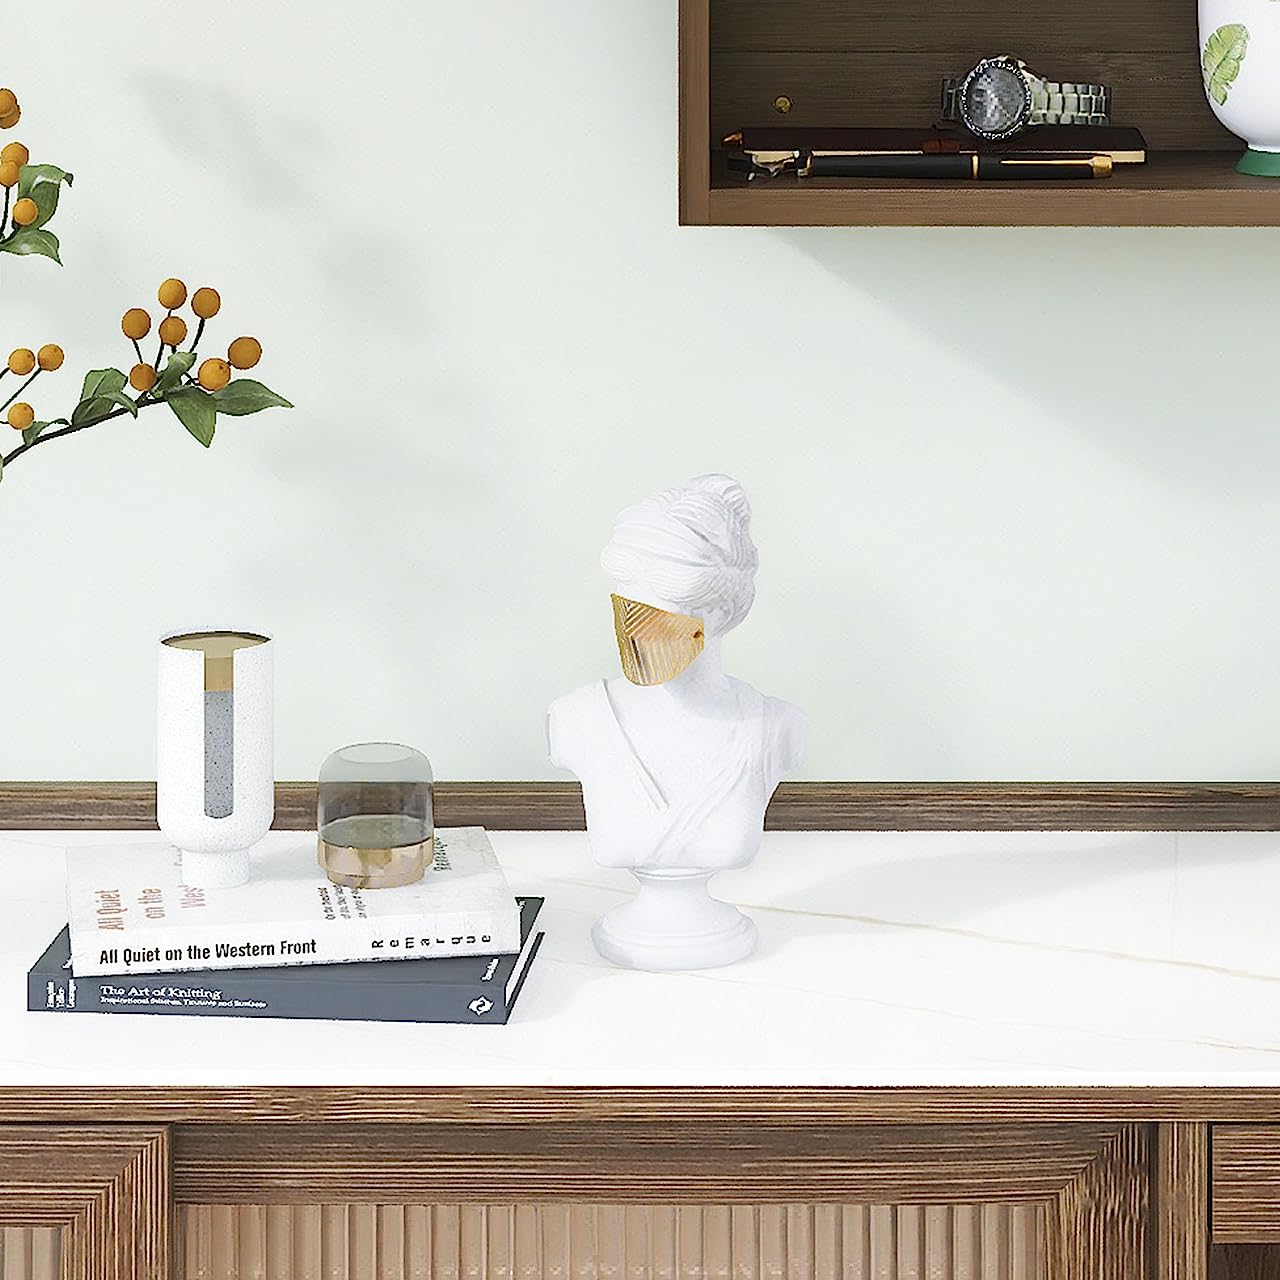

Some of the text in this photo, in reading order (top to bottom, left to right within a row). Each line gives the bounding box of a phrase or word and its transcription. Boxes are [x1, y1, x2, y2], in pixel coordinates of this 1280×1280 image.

[94, 889, 128, 916] Quiet
[138, 887, 166, 919] on the
[100, 950, 118, 964] All
[123, 947, 161, 965] Quiet
[165, 949, 183, 961] on
[187, 945, 211, 960] the
[215, 942, 275, 958] Western
[281, 938, 317, 956] Front
[100, 985, 222, 1001] The Art of Knitting
